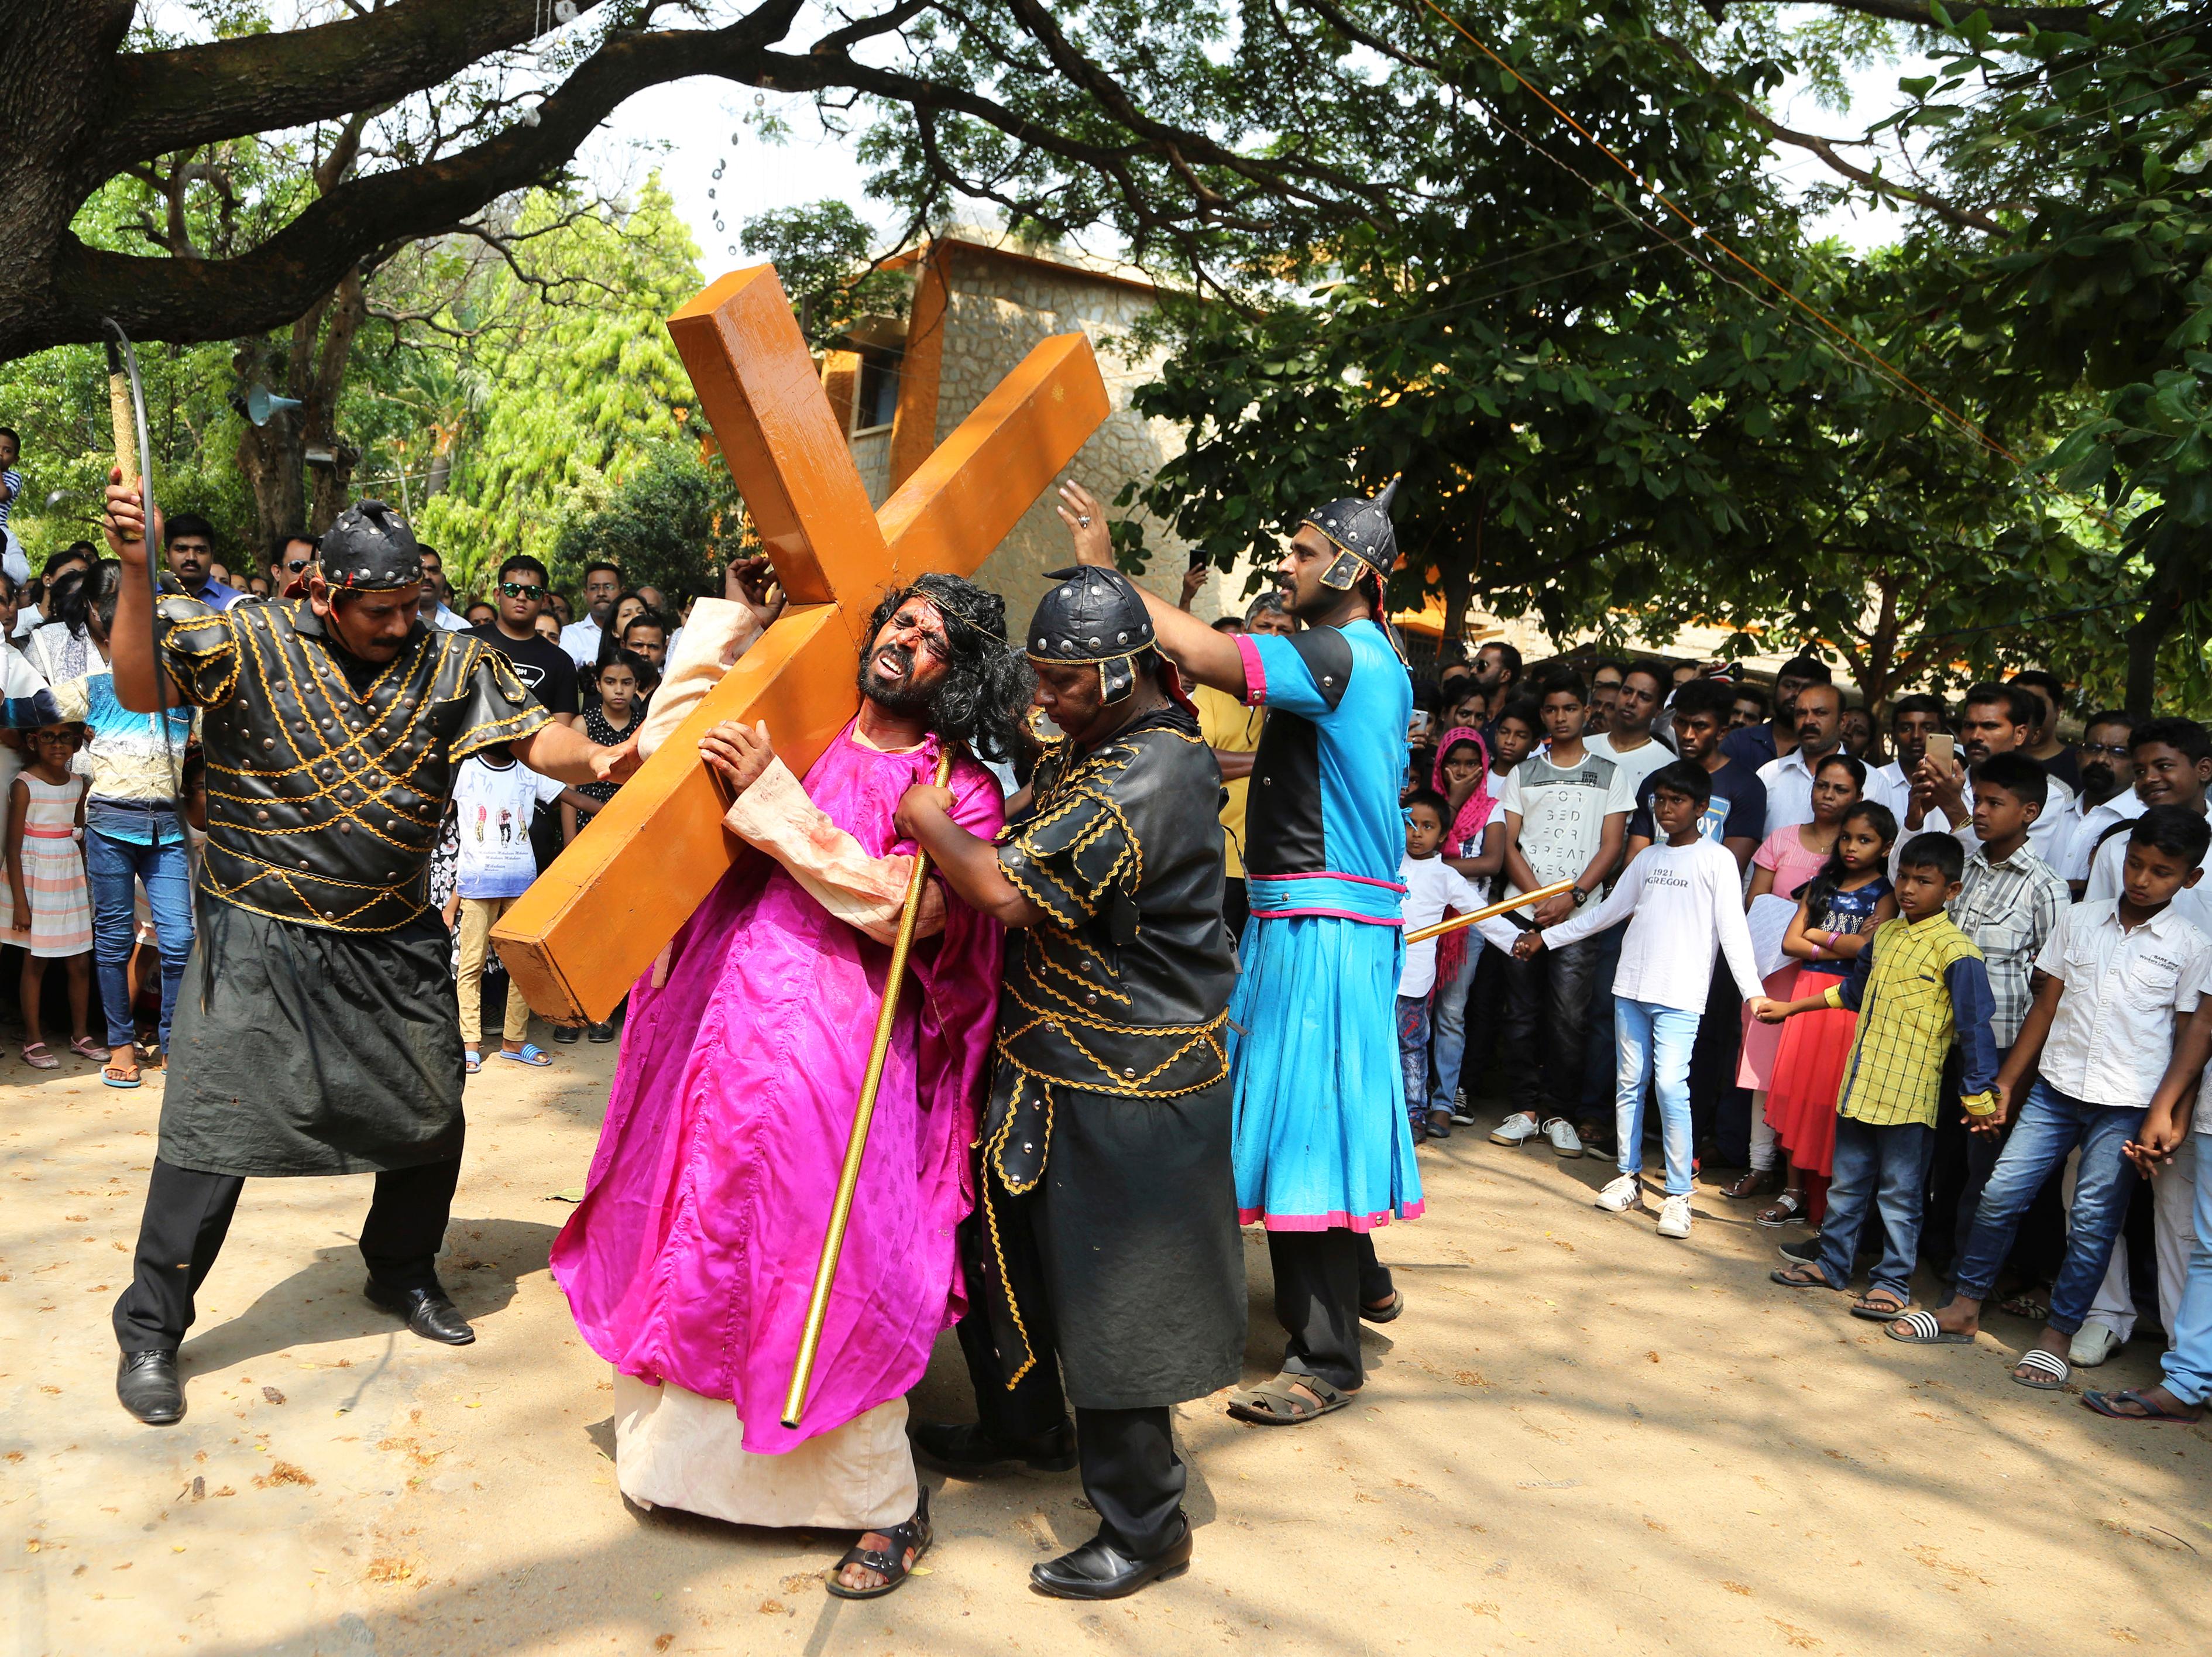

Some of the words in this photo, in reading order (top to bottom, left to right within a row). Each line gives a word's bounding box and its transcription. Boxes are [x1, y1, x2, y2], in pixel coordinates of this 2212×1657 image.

[1529, 845, 1585, 861] GREAT
[1531, 862, 1578, 879] NESS
[1653, 869, 1673, 877] 1921
[1644, 877, 1688, 887] GREGOR
